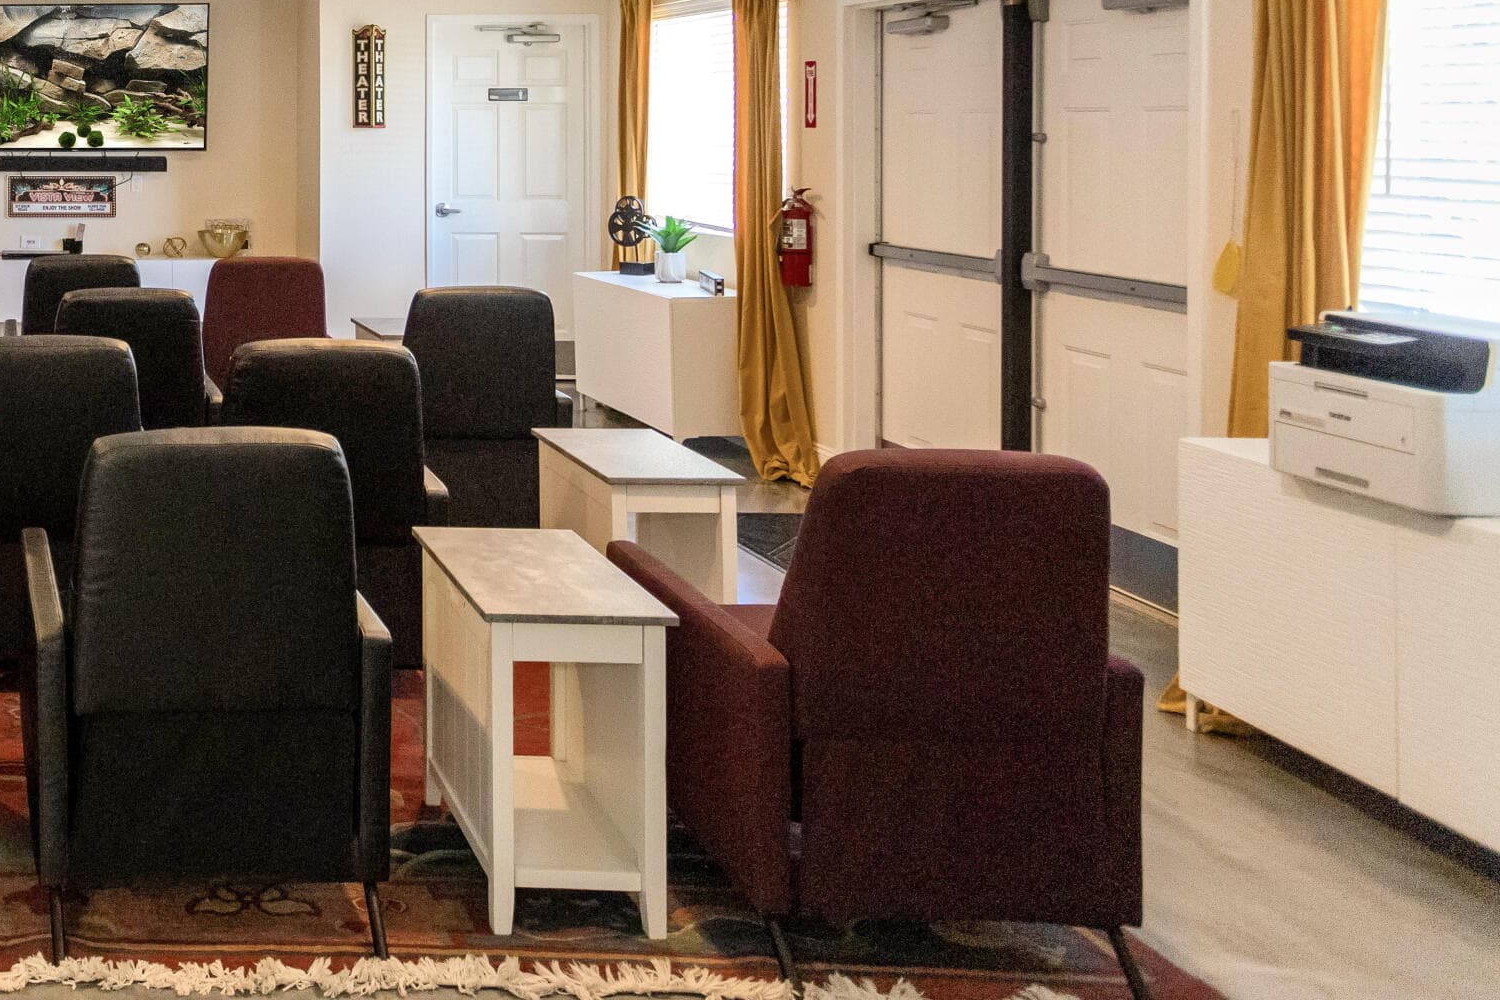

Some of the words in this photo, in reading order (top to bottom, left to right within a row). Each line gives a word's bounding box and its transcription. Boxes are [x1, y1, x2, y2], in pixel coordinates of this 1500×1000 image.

[356, 39, 369, 124] THEATER
[374, 39, 384, 124] THEATER
[29, 192, 62, 202] VISTA
[63, 192, 95, 202] VIEW
